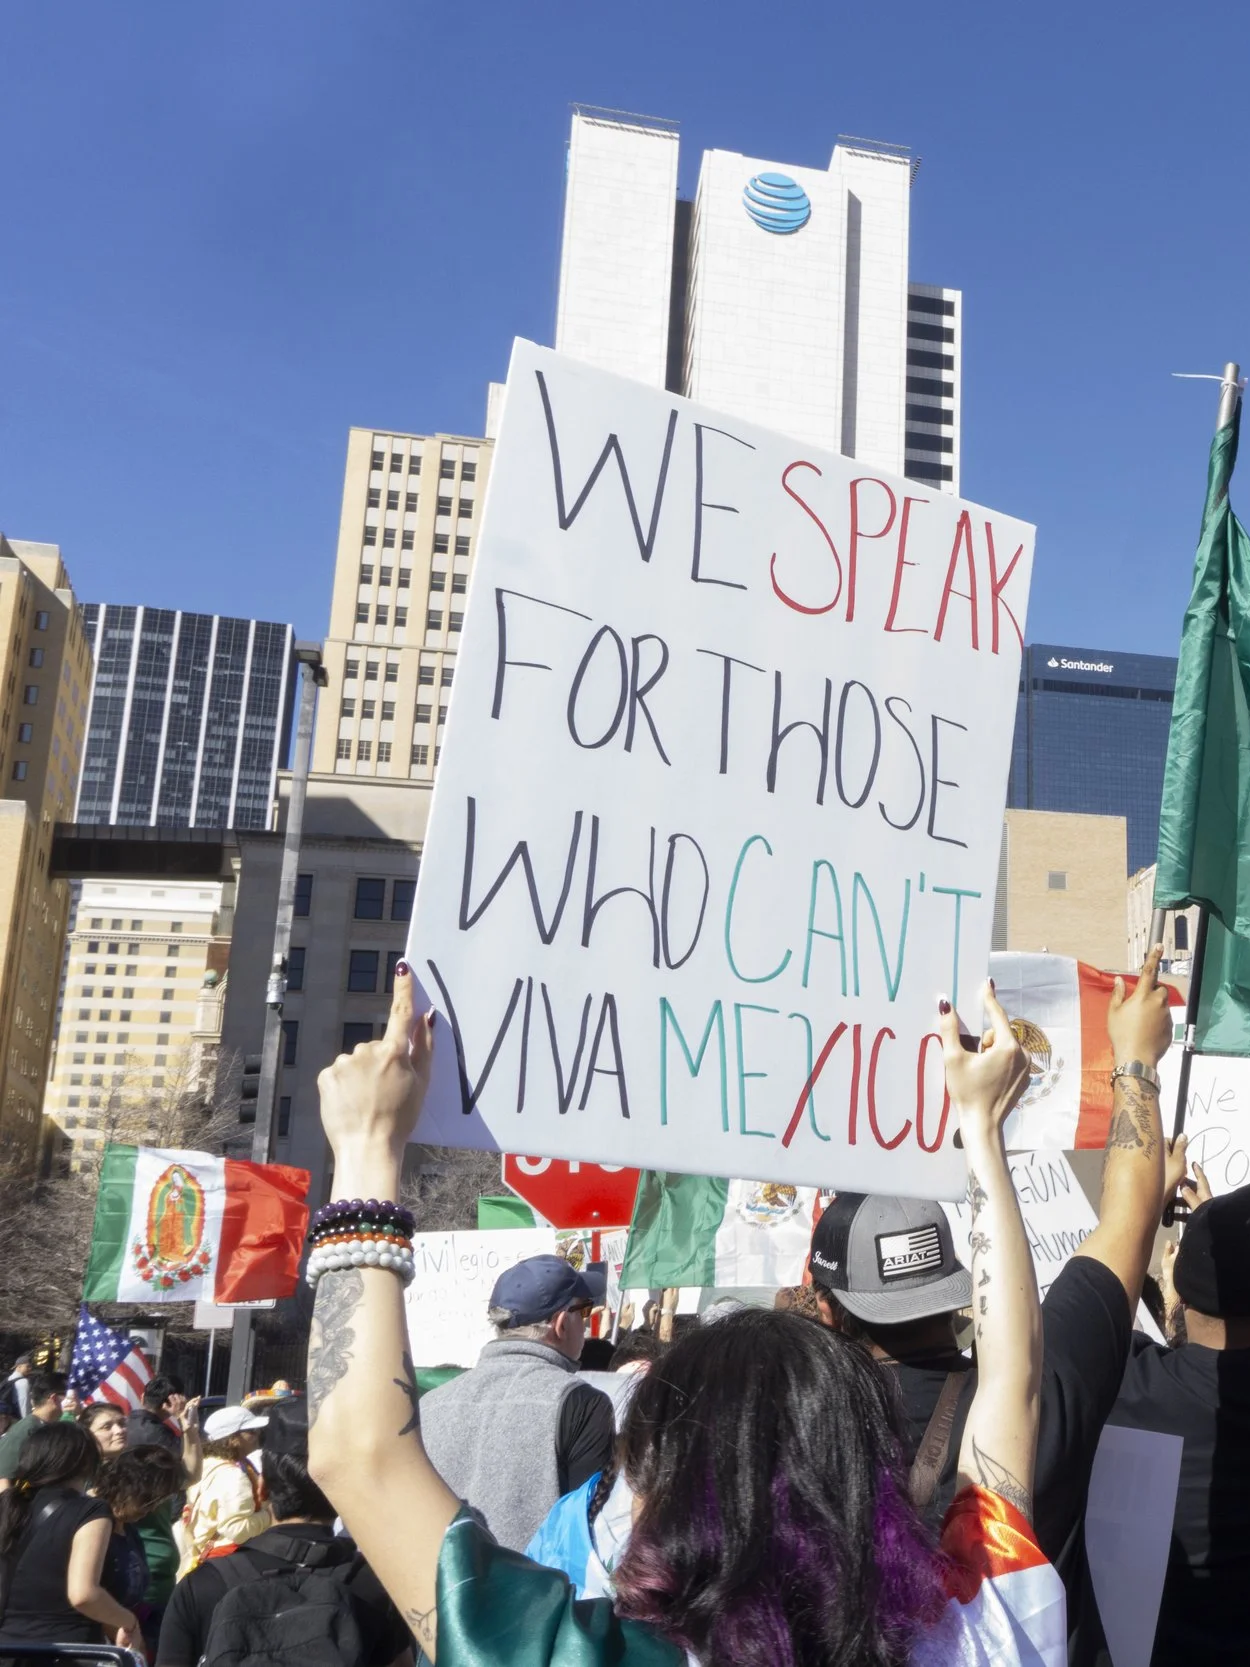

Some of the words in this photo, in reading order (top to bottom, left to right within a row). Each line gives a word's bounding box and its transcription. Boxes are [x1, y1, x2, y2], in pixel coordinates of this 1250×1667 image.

[534, 369, 757, 591] WE
[769, 460, 1025, 656] SPEAK
[491, 587, 671, 766] FOR
[696, 648, 969, 848] THOSE
[1060, 658, 1114, 673] Santander
[459, 796, 709, 970] WHO
[724, 835, 982, 1008] CAN'T
[427, 959, 630, 1119] VIVA
[1186, 1077, 1238, 1117] We
[883, 1250, 928, 1268] ARIAT
